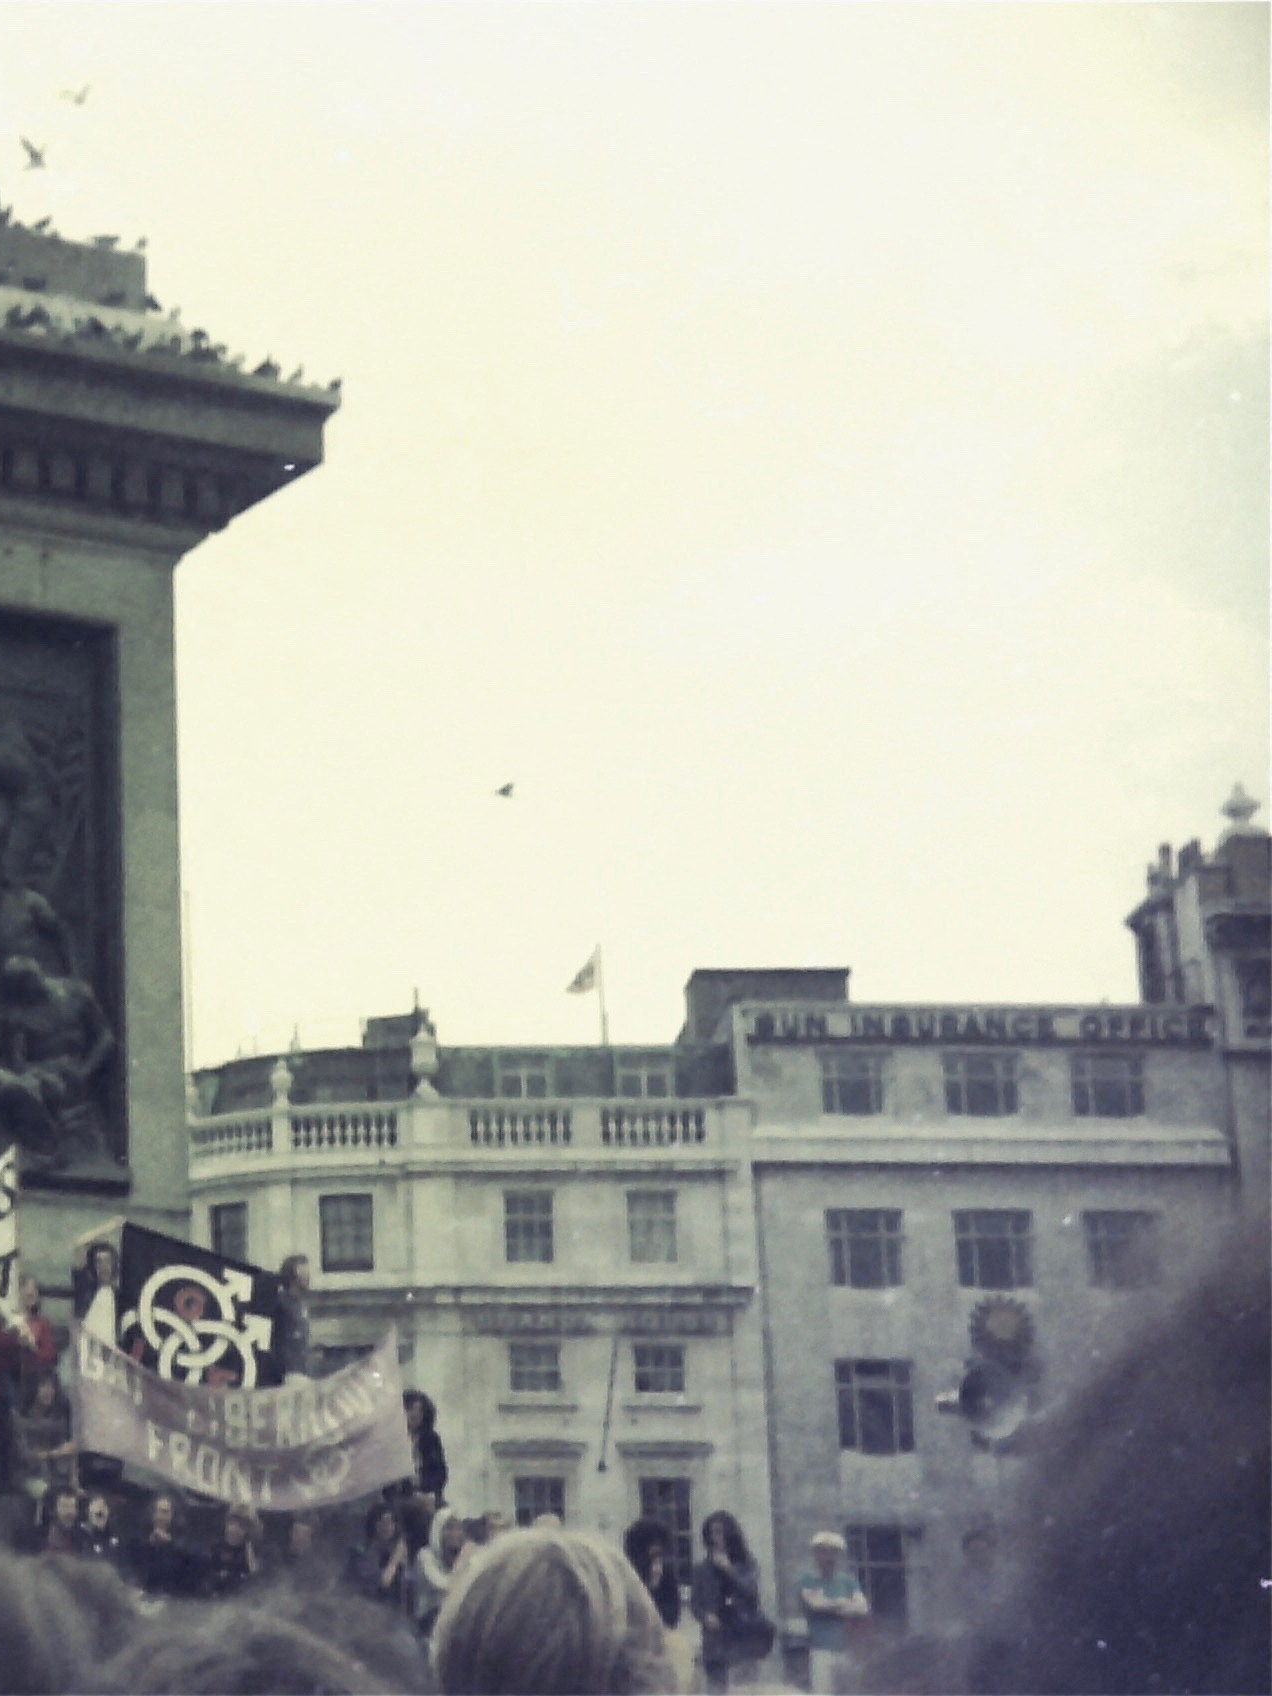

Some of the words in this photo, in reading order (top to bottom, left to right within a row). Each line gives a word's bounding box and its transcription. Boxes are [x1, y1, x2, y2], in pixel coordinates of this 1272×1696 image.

[754, 1012, 827, 1040] SUN
[849, 1012, 1056, 1041] INSURANCE
[1080, 1013, 1210, 1043] OFFICE
